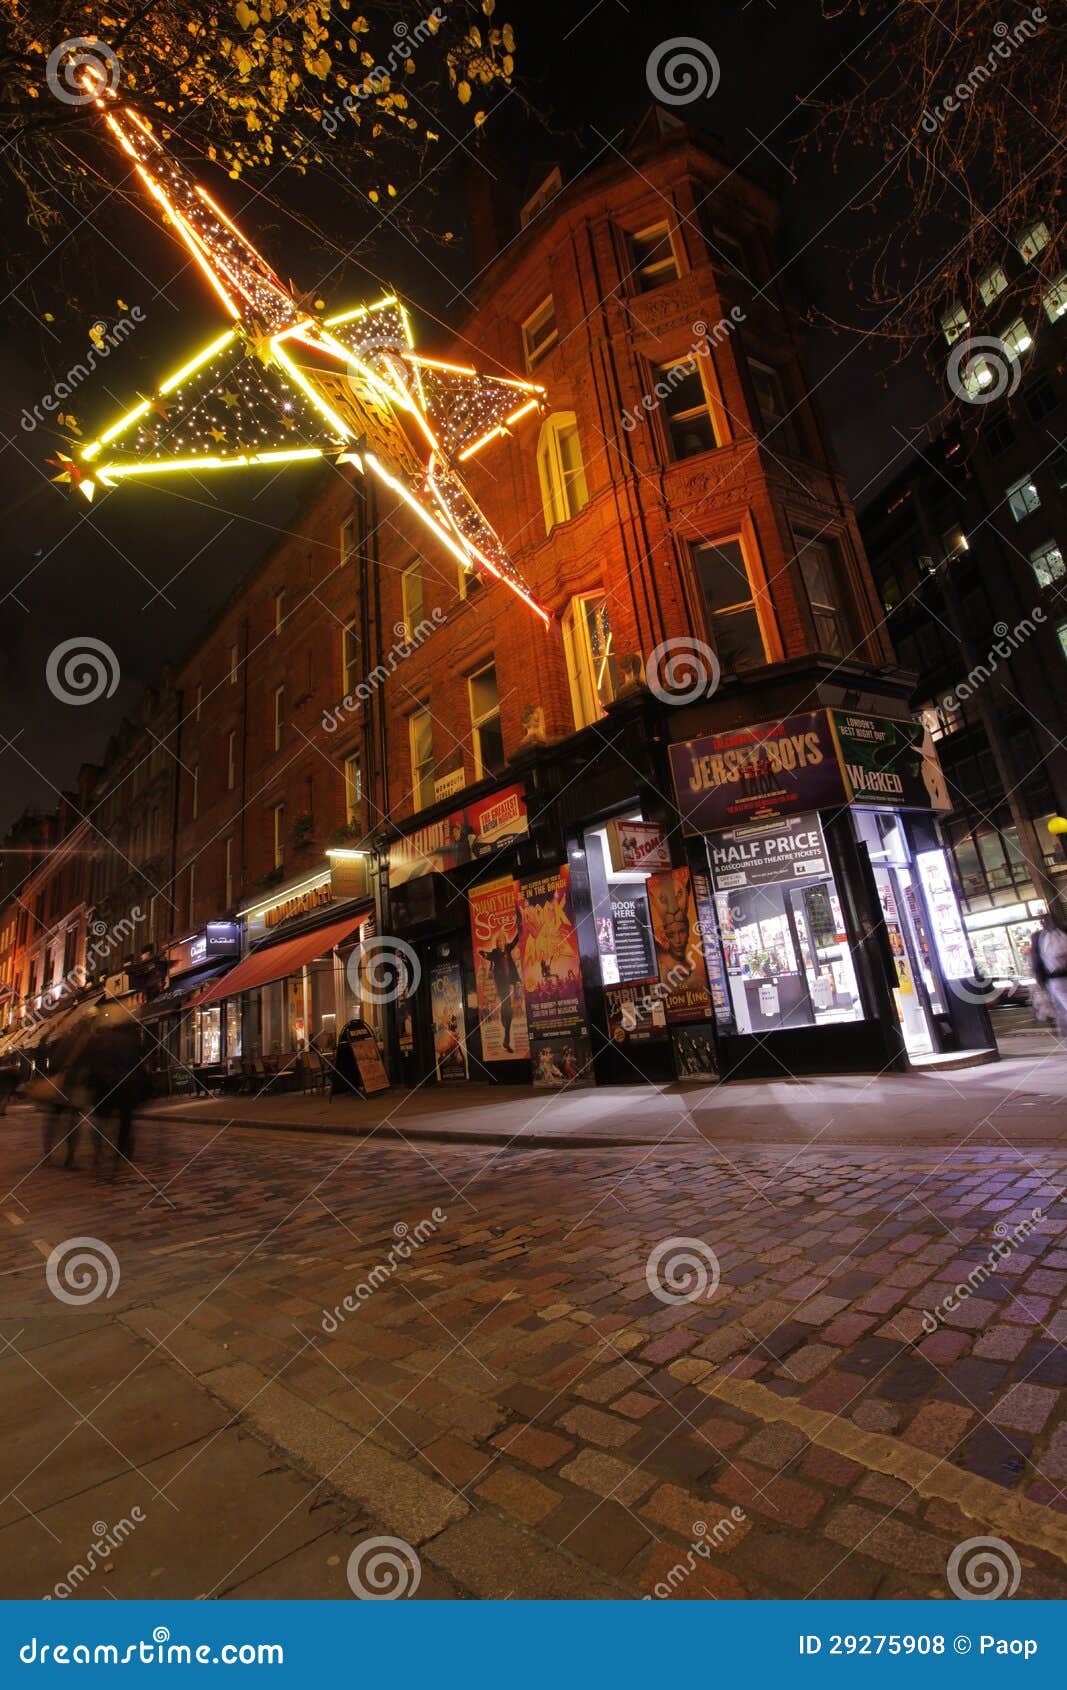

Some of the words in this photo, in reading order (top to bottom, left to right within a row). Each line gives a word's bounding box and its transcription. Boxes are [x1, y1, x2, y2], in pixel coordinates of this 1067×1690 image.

[689, 745, 760, 793] JERSEY
[766, 731, 824, 774] BOYS
[845, 764, 904, 793] WICKED
[713, 842, 760, 865] HALF
[764, 831, 821, 856] PRICE
[720, 858, 764, 873] DISCOUNTED
[763, 852, 794, 865] THEATRE
[794, 848, 822, 860] TICKETS
[611, 901, 636, 911] BOOK
[613, 909, 636, 918] HERE
[665, 995, 685, 1009] LION
[686, 990, 708, 1007] KING
